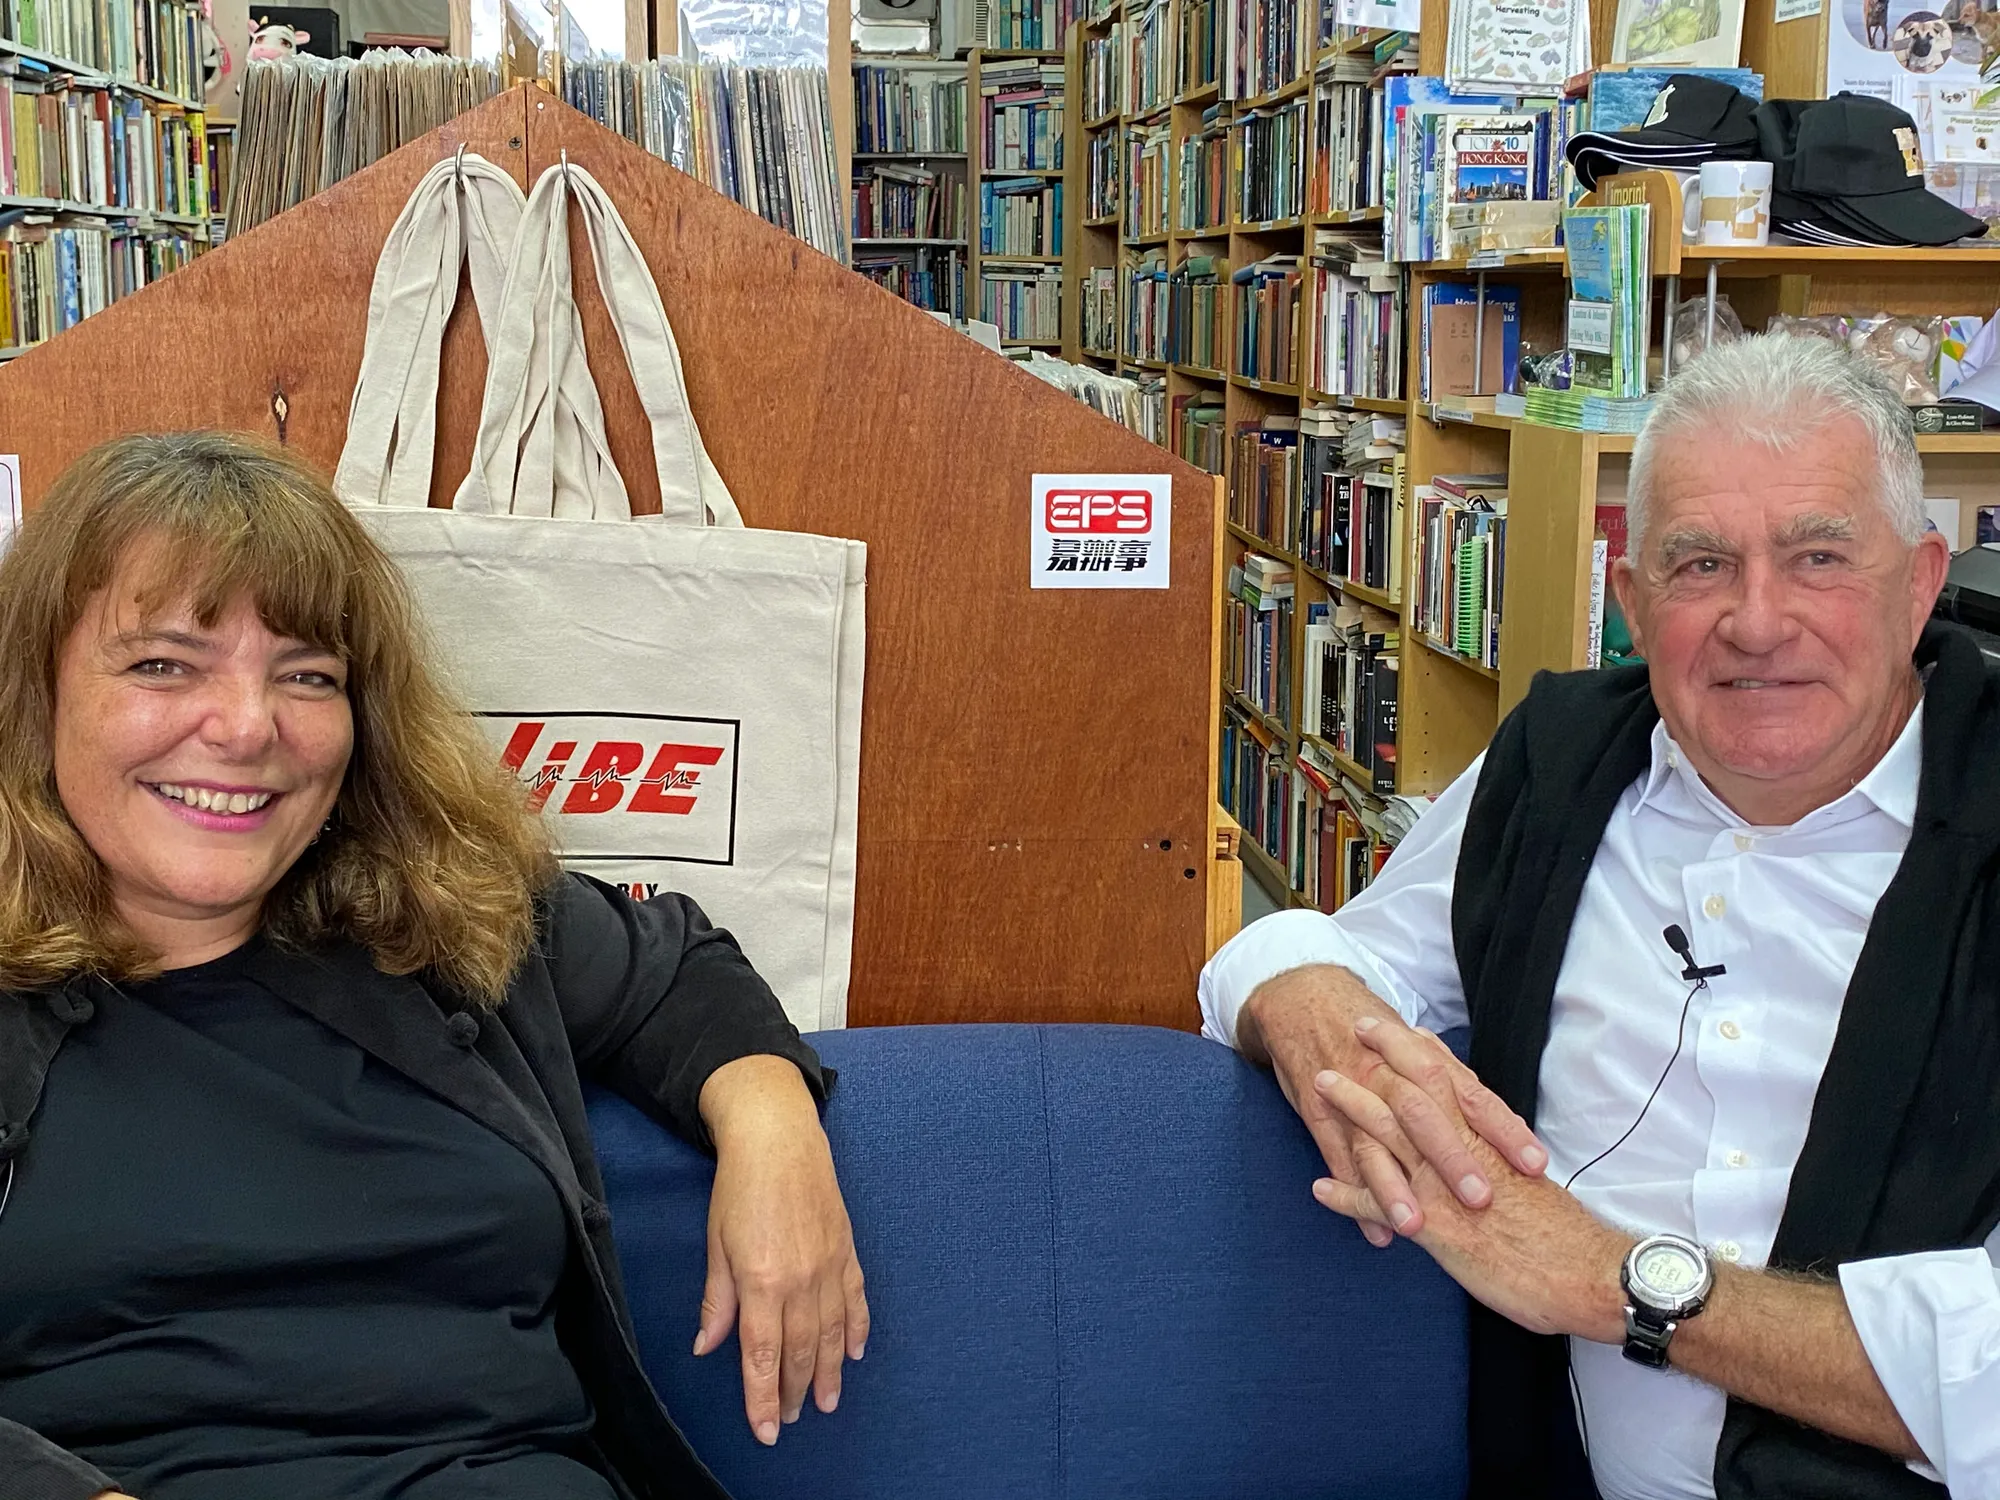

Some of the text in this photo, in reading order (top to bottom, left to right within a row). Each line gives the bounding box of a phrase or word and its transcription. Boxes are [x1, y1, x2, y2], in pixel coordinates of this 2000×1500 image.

[1496, 5, 1540, 17] Harvesting
[1500, 49, 1531, 58] Hong Kong
[1466, 136, 1519, 150] TOP 10
[1461, 153, 1526, 164] HONG KONG
[1050, 494, 1148, 528] EPS
[1045, 538, 1151, 571] 易辦事
